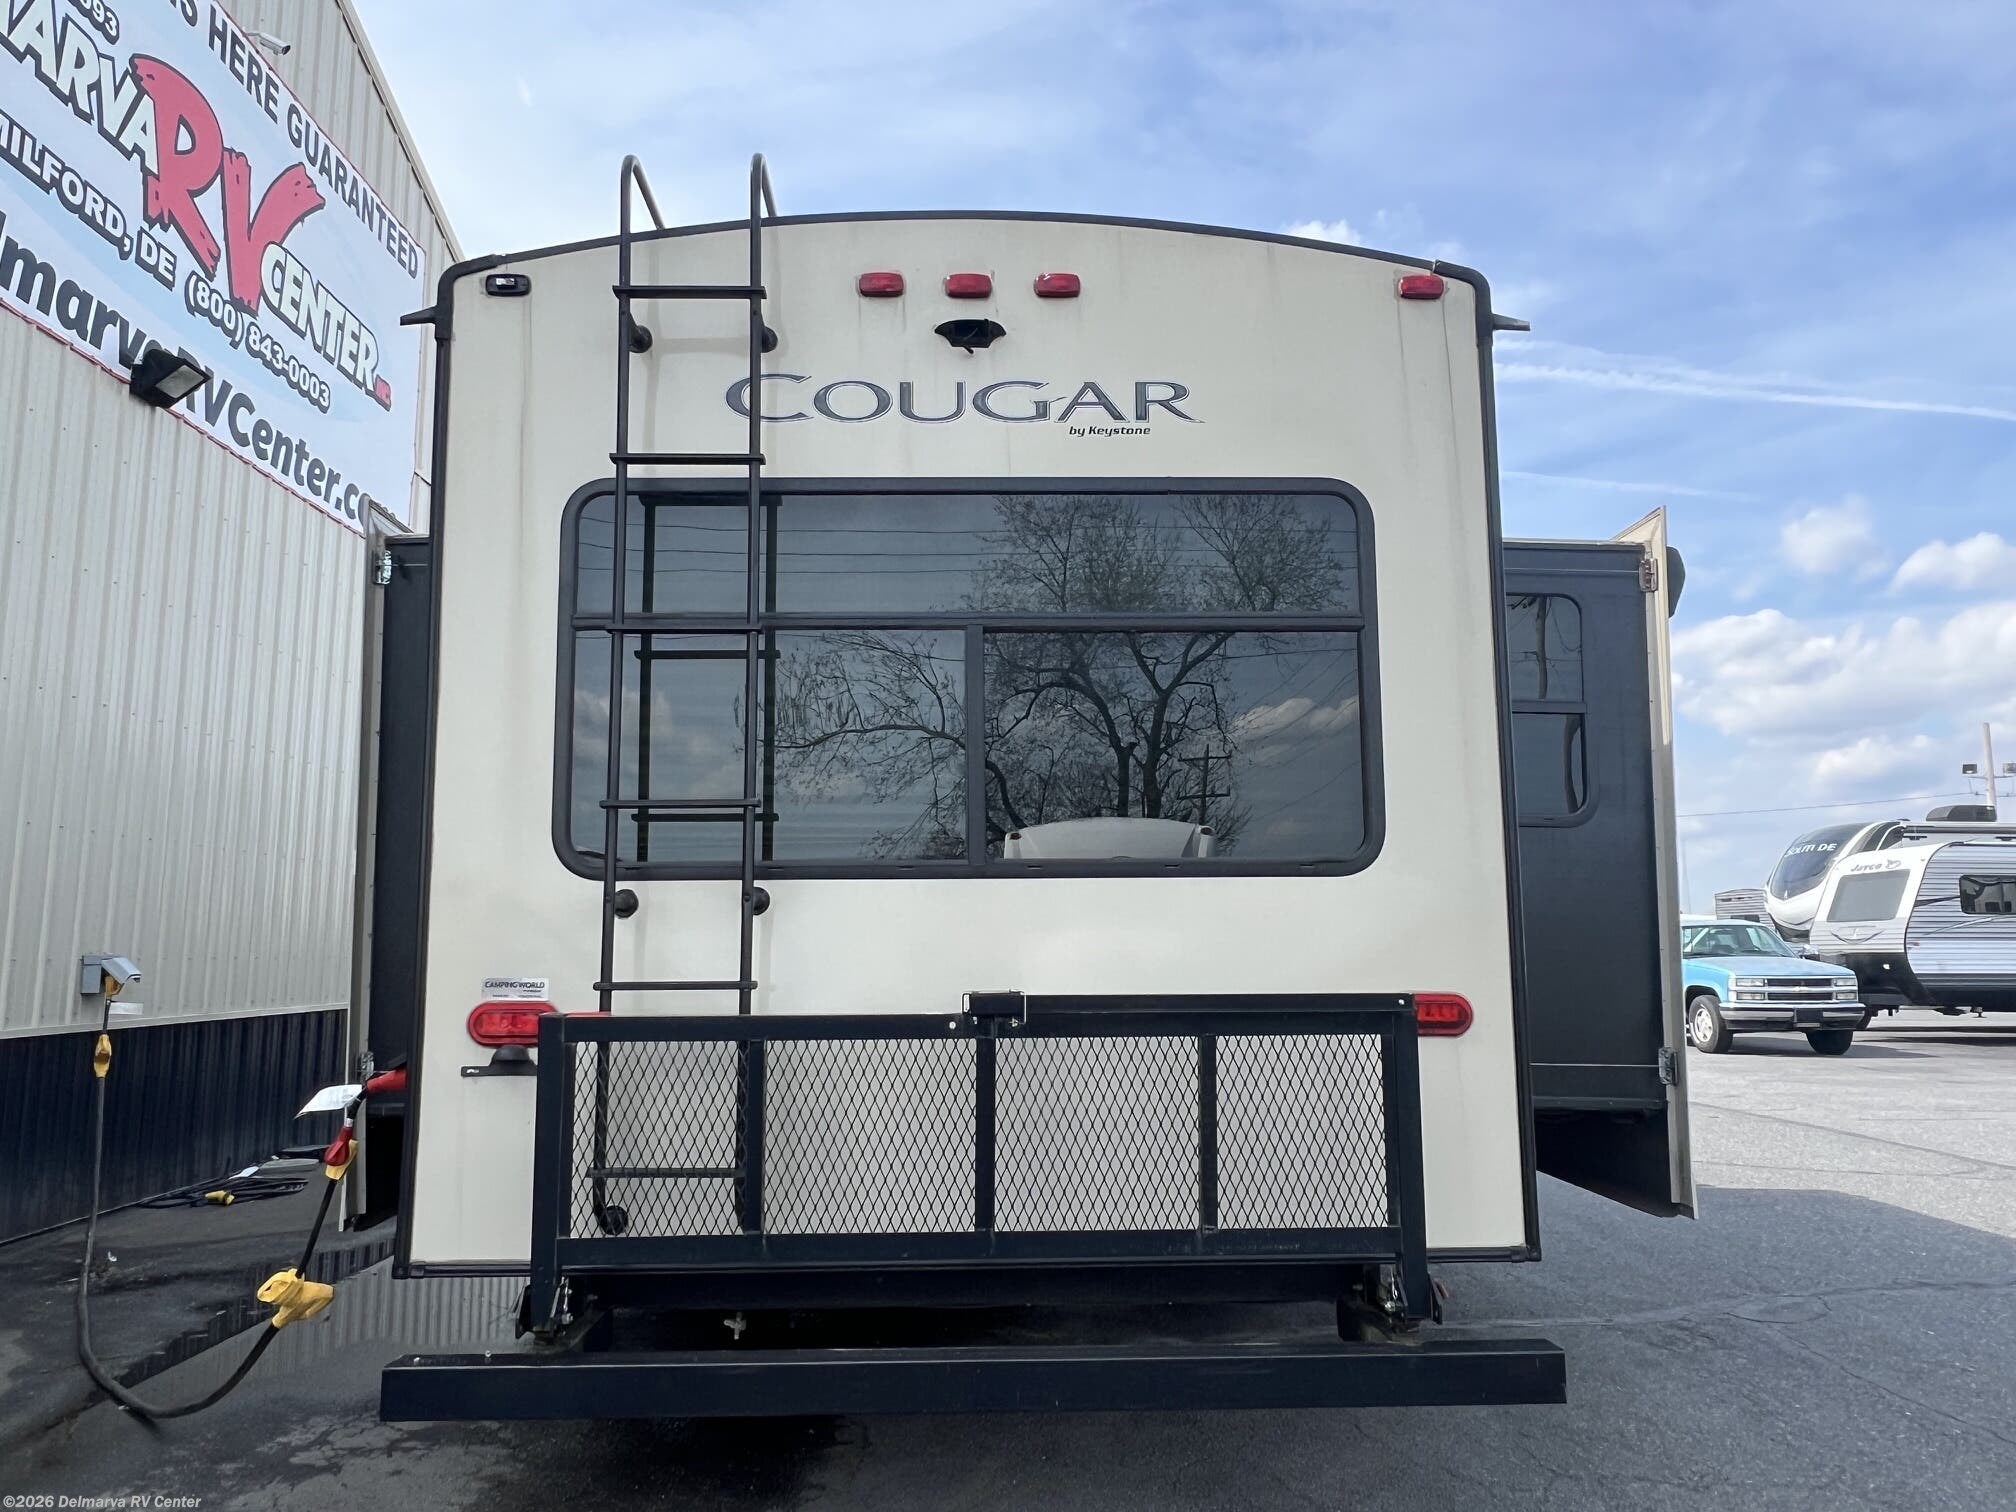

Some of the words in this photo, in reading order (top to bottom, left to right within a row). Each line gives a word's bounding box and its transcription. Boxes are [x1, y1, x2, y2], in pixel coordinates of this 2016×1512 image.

[128, 53, 327, 318] RV
[260, 241, 378, 397] CENTER
[208, 4, 280, 124] HERE
[287, 103, 419, 279] GUARANTEED
[135, 226, 177, 291] DE
[185, 270, 247, 350] (800)
[245, 321, 331, 414] 843-0003
[725, 373, 1204, 424] COUGAR
[1069, 426, 1086, 437] by
[1088, 426, 1151, 437] Keystone
